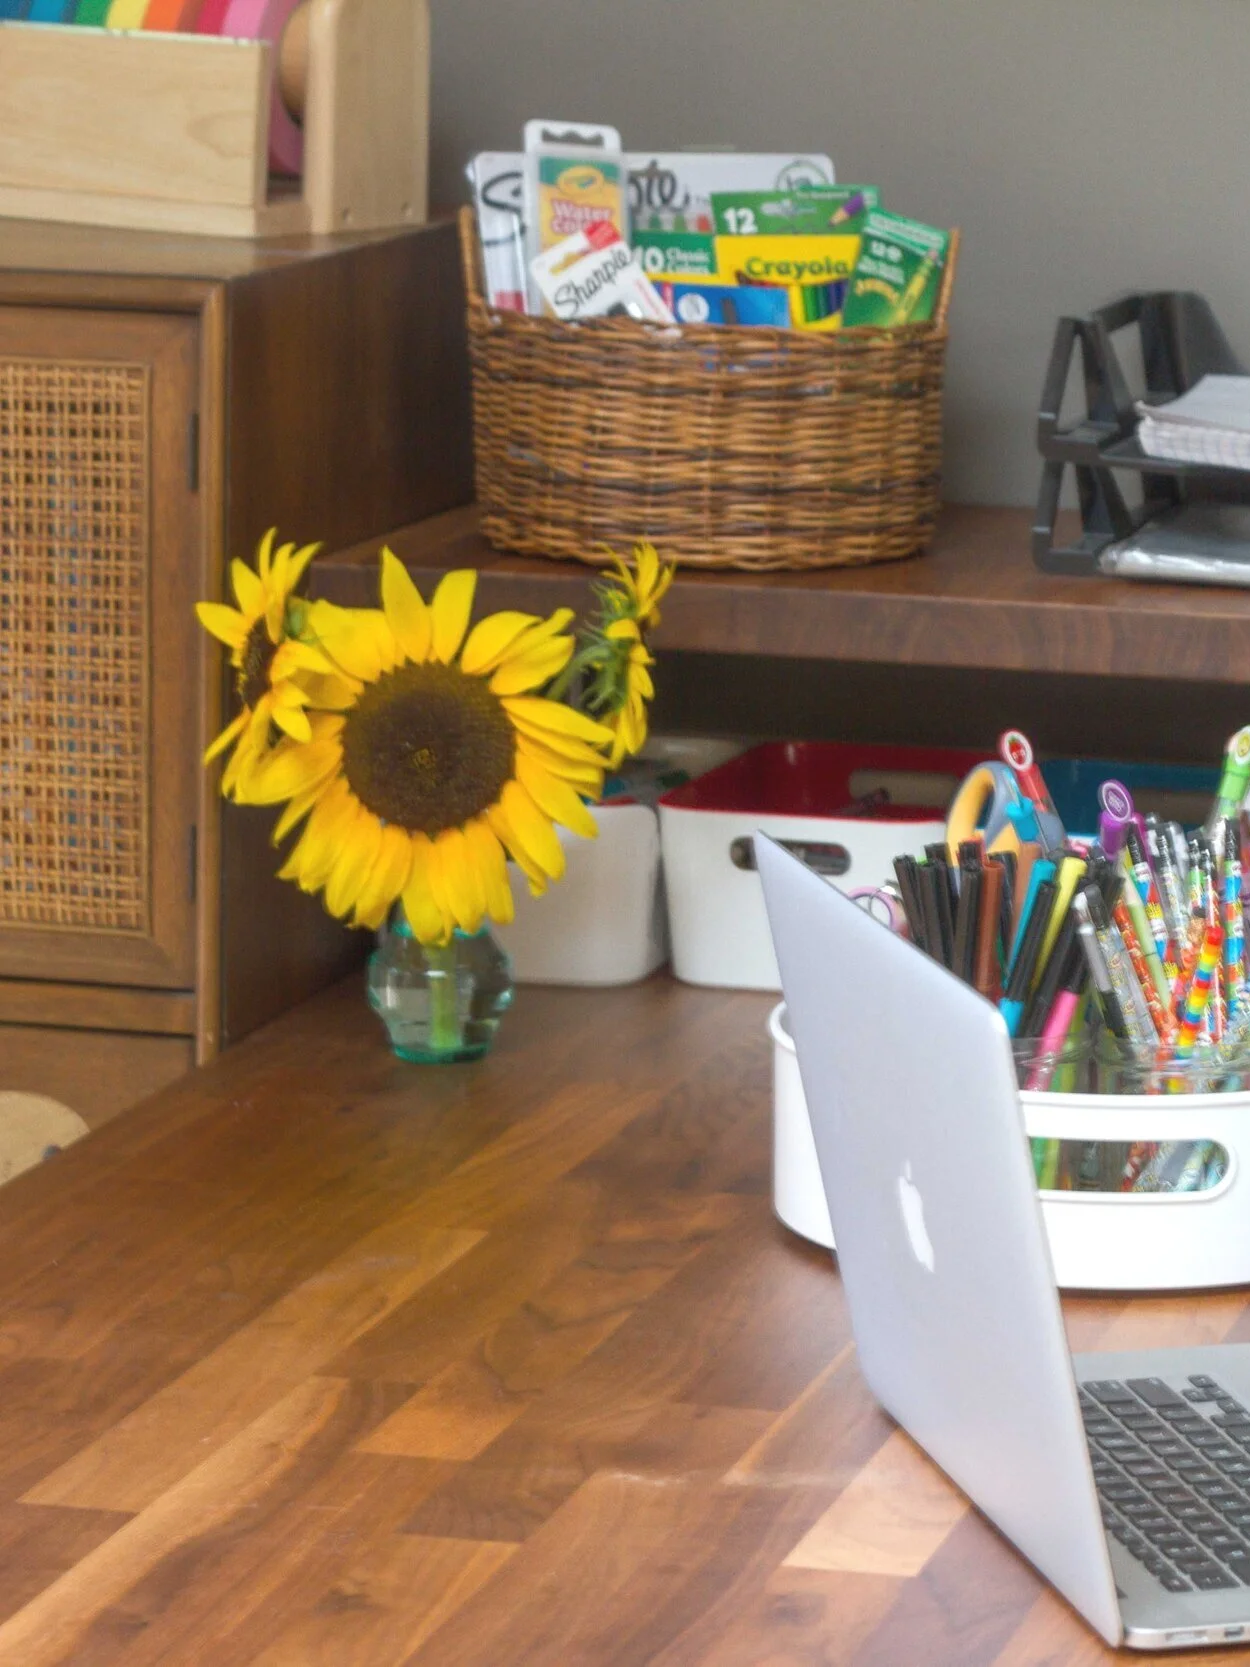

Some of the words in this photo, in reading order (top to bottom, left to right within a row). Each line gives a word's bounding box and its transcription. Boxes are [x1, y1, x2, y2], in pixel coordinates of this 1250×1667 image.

[723, 207, 758, 234] 12
[745, 256, 849, 279] Crayola
[554, 248, 632, 317] Sharpie
